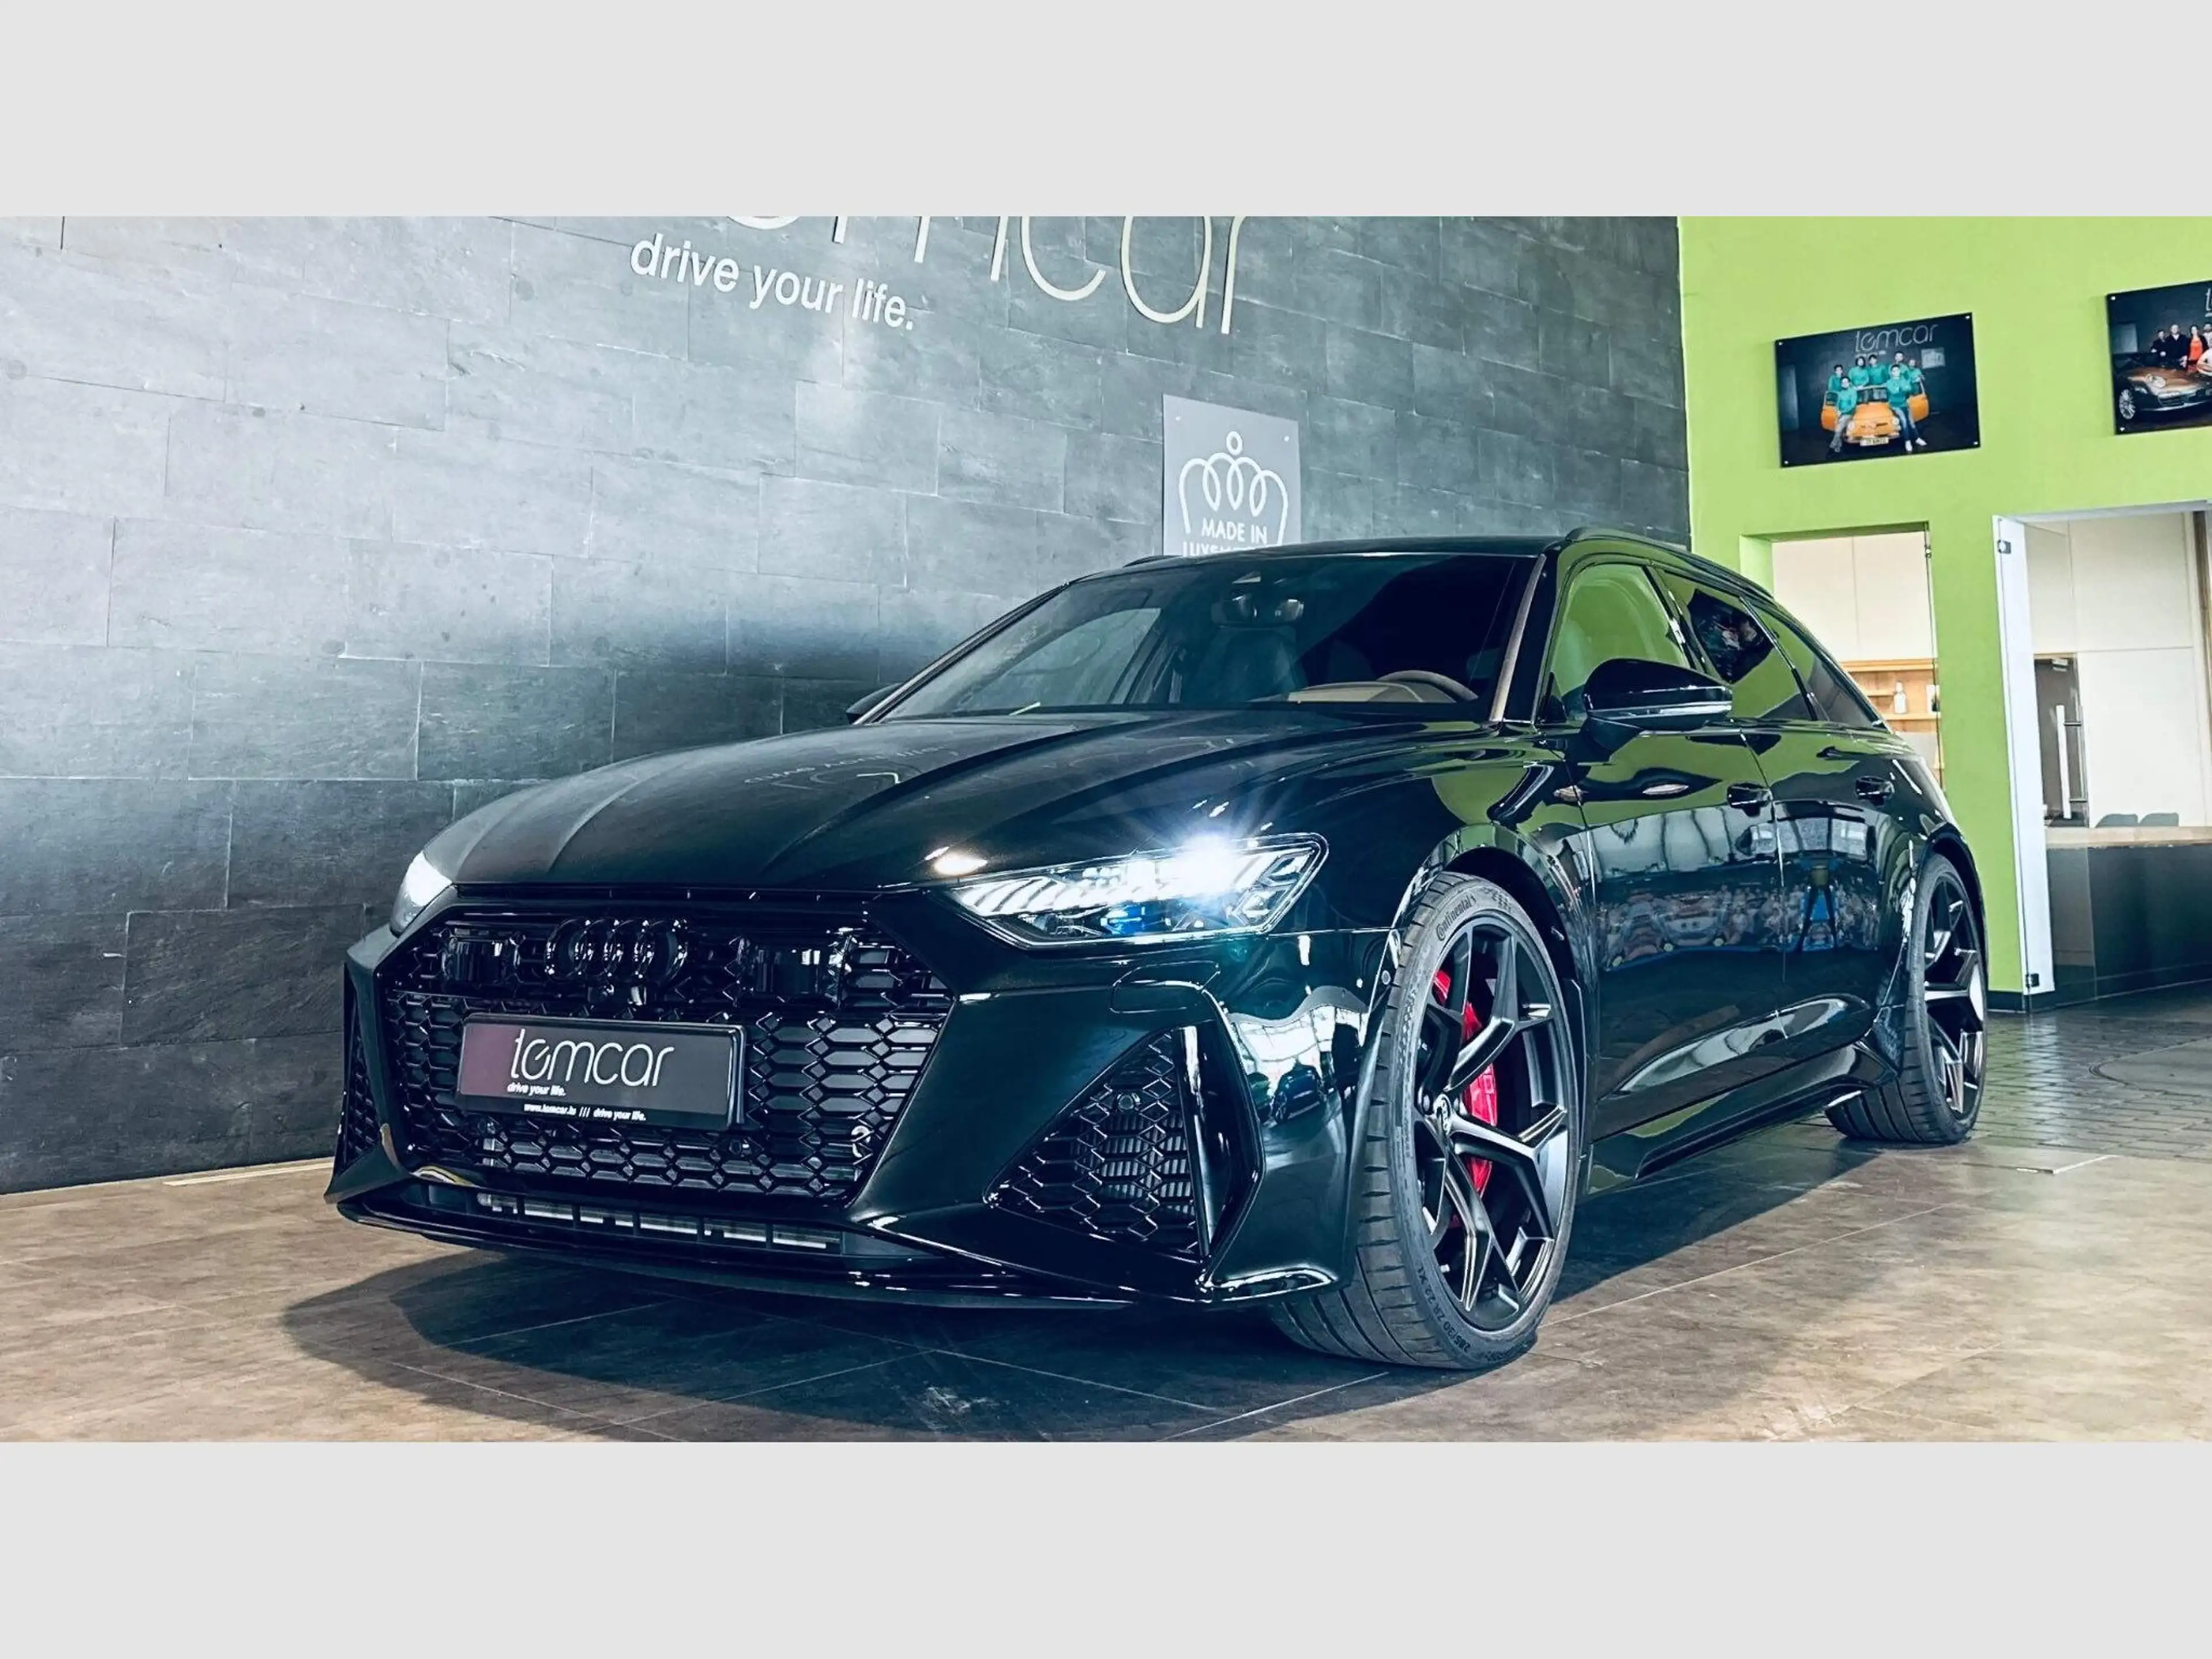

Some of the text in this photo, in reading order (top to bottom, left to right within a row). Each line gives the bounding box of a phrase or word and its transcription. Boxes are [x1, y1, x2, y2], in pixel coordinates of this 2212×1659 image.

[630, 232, 914, 331] drive your life.
[1201, 517, 1267, 544] MADE IN
[510, 1028, 675, 1087] tomcar
[507, 1082, 529, 1093] drive
[529, 1085, 550, 1096] your
[593, 1108, 613, 1119] drive
[613, 1111, 632, 1122] your
